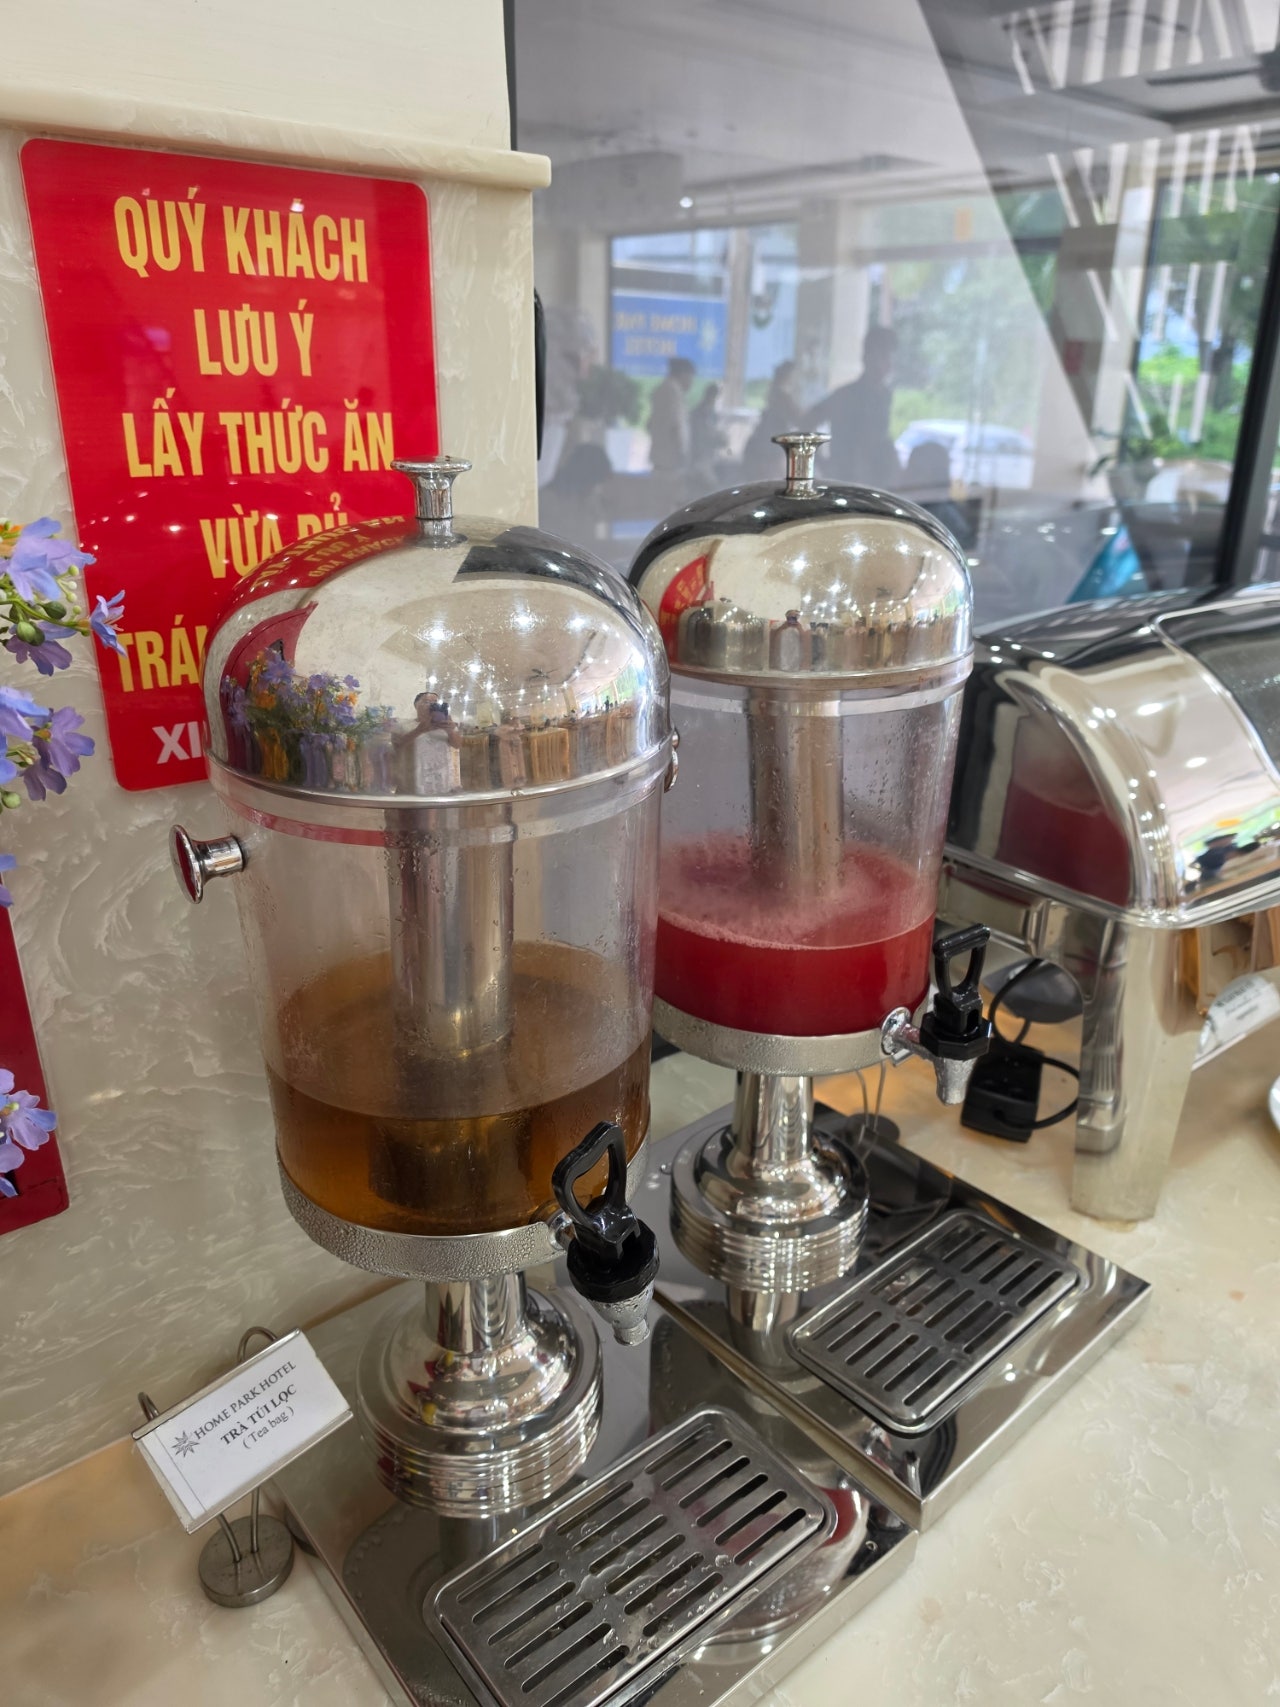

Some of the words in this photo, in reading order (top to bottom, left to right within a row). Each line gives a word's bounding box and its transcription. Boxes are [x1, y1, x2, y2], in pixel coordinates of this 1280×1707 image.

[114, 187, 206, 278] QUÝ
[222, 198, 368, 283] KHÁCH
[193, 303, 278, 377] LƯU
[289, 298, 314, 377] Ý
[122, 387, 204, 478] LẤY
[219, 398, 329, 475] THỨC
[343, 398, 394, 472] ĂN
[199, 503, 284, 579] VỪA
[194, 1408, 231, 1440] HOME
[230, 1387, 261, 1413] PARK
[259, 1361, 296, 1391] HOTEL
[221, 1421, 249, 1445] TRÀ
[247, 1404, 271, 1424] TÚI
[270, 1384, 297, 1408] LỌC
